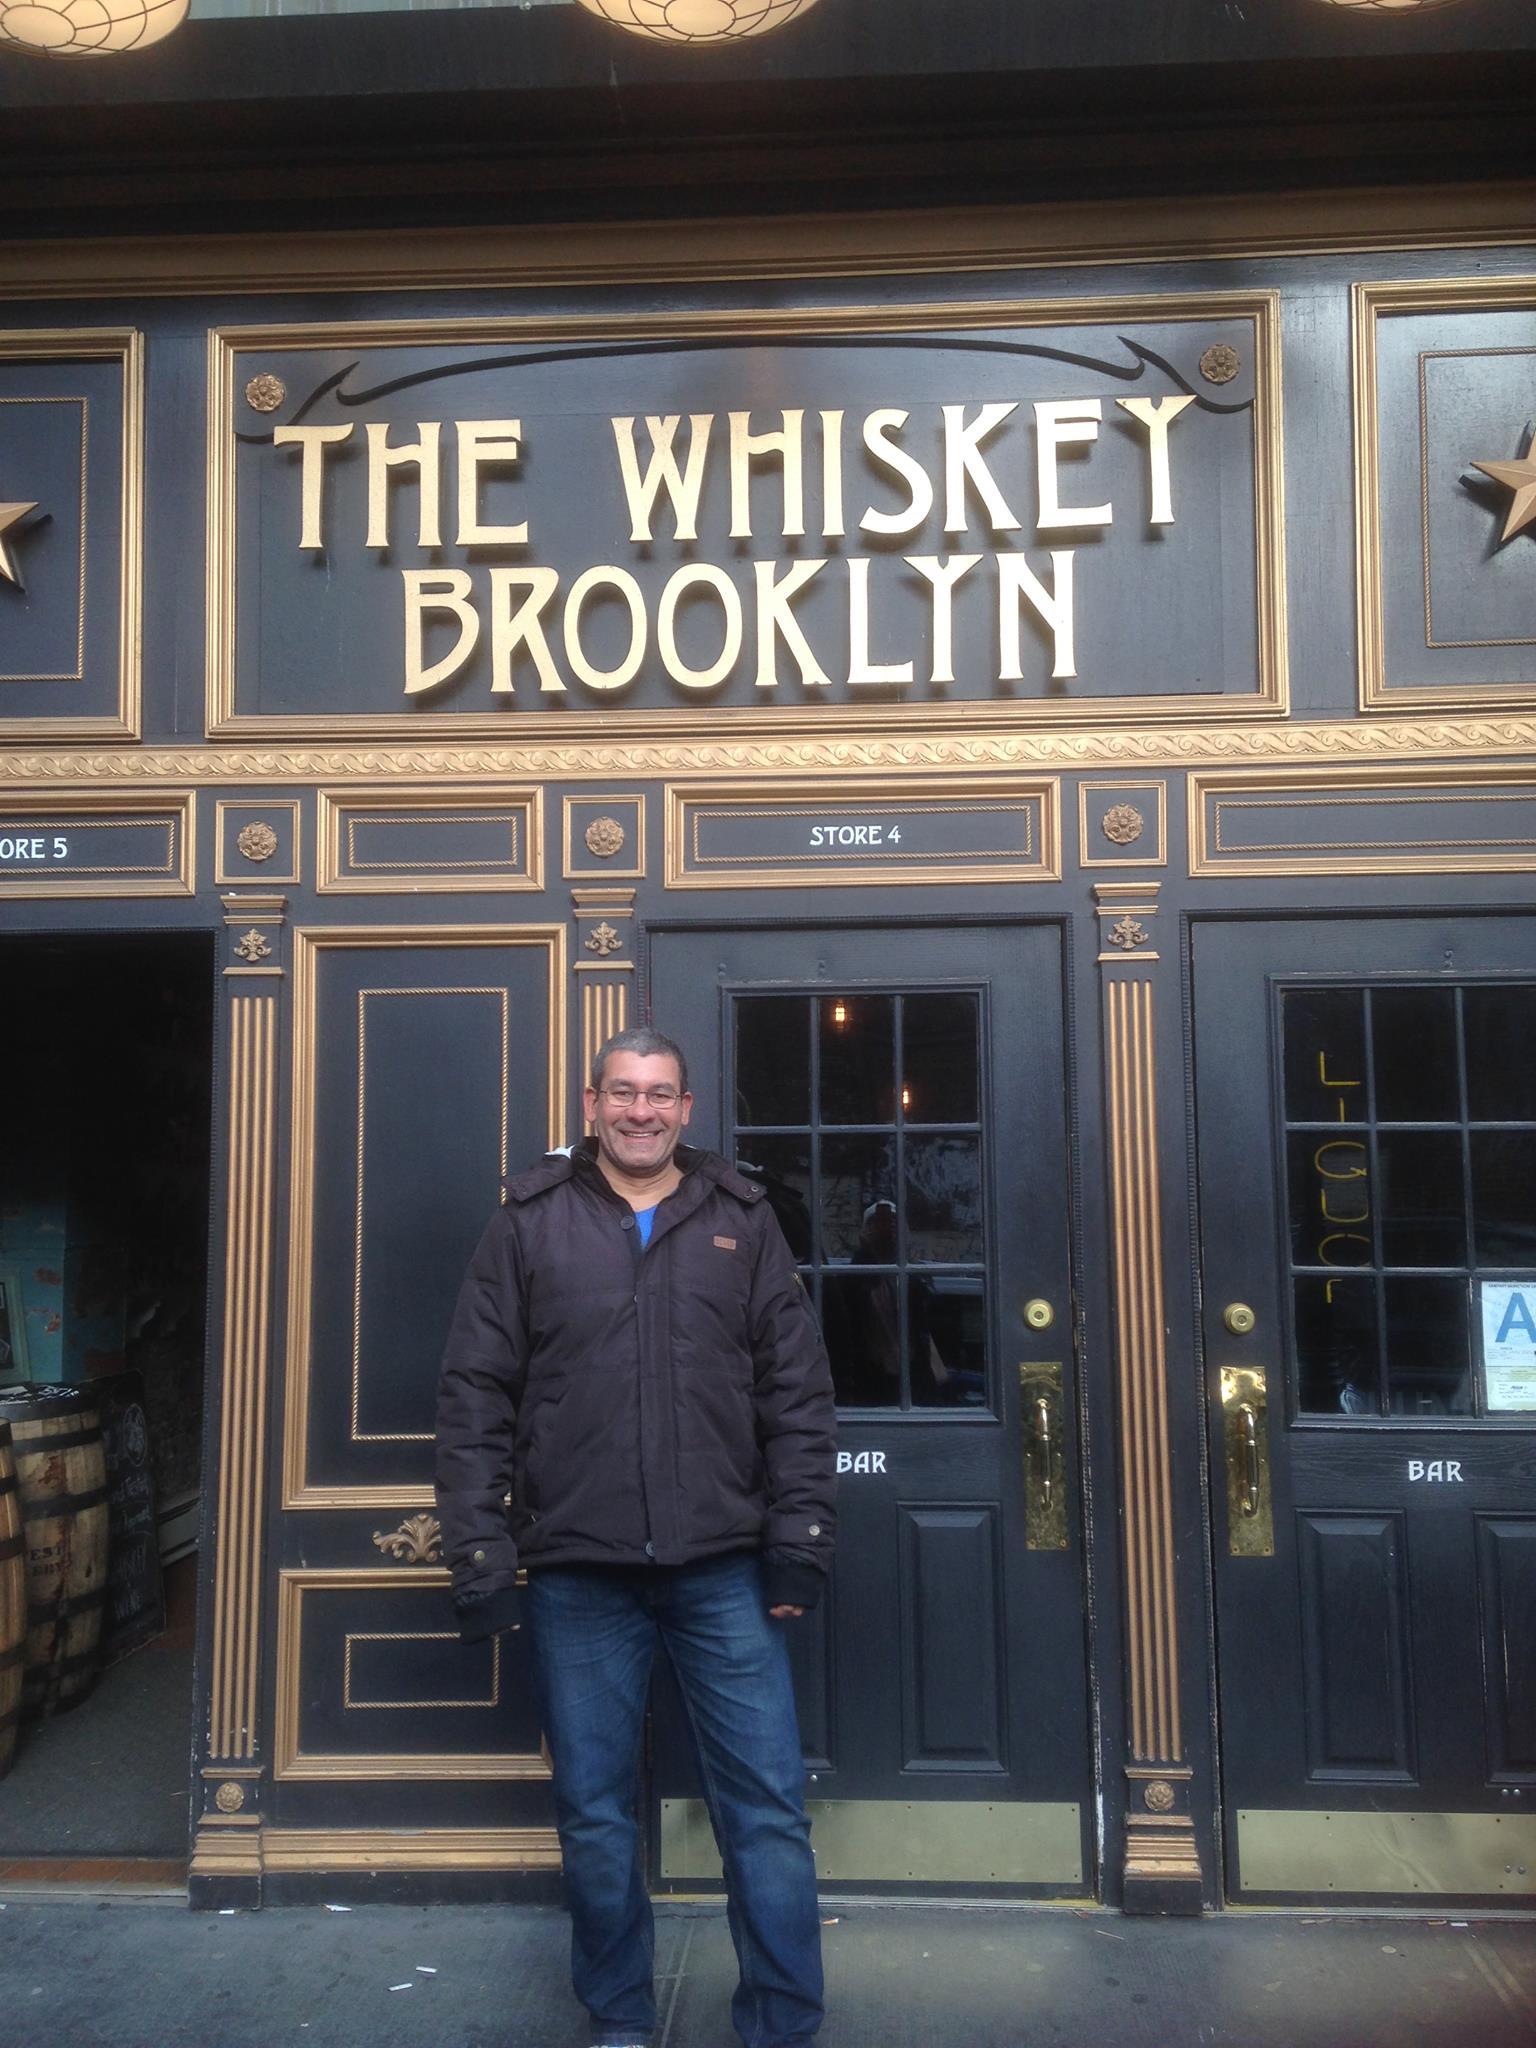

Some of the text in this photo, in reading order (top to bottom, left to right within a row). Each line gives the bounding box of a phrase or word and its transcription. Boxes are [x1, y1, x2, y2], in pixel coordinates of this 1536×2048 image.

[273, 395, 1197, 549] THE WHISKEY
[402, 549, 1078, 695] BROOKLYN
[809, 824, 903, 847] STORE 4
[52, 837, 69, 859] 5
[1495, 1291, 1536, 1343] A
[835, 1450, 888, 1474] BAR
[1408, 1460, 1465, 1483] BAR
